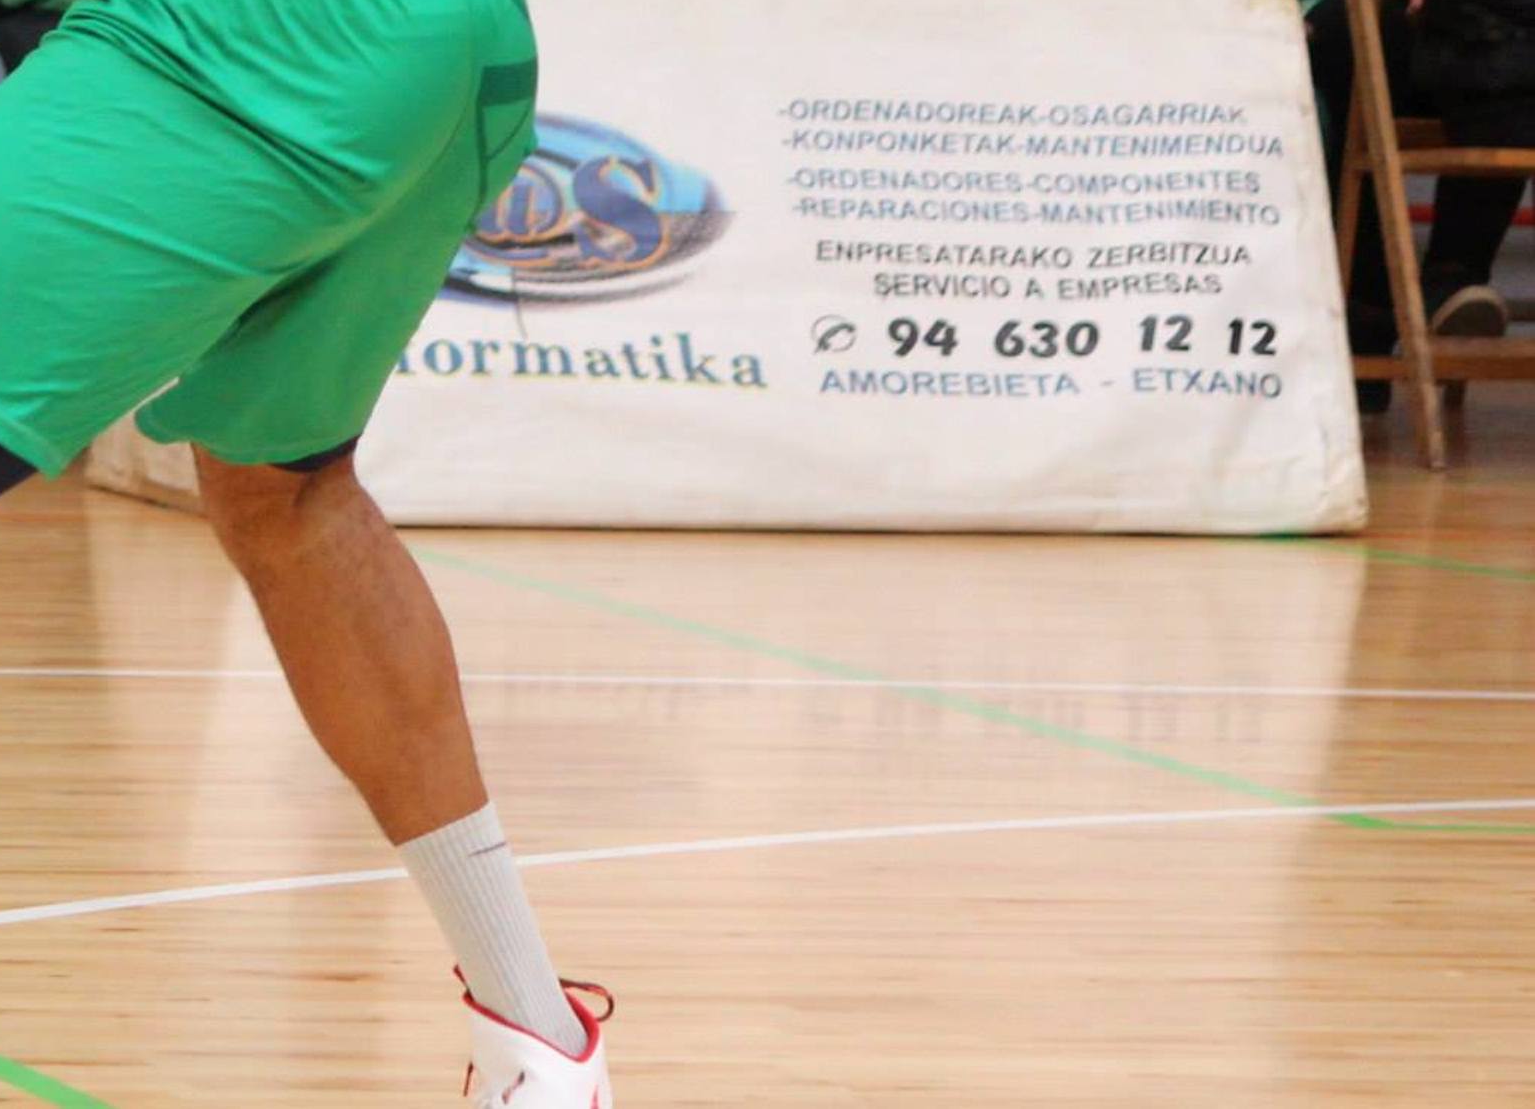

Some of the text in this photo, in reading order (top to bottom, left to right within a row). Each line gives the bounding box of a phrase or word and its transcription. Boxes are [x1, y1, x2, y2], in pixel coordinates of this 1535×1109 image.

[816, 240, 1253, 270] ENPRESATARAKO ZERBITZUA
[873, 272, 1223, 301] SERVICIO A EMPRESAS
[887, 314, 1278, 359] 94 630 12 12
[819, 368, 1081, 397] AMOREBIETA
[1132, 367, 1283, 400] ETXANO
